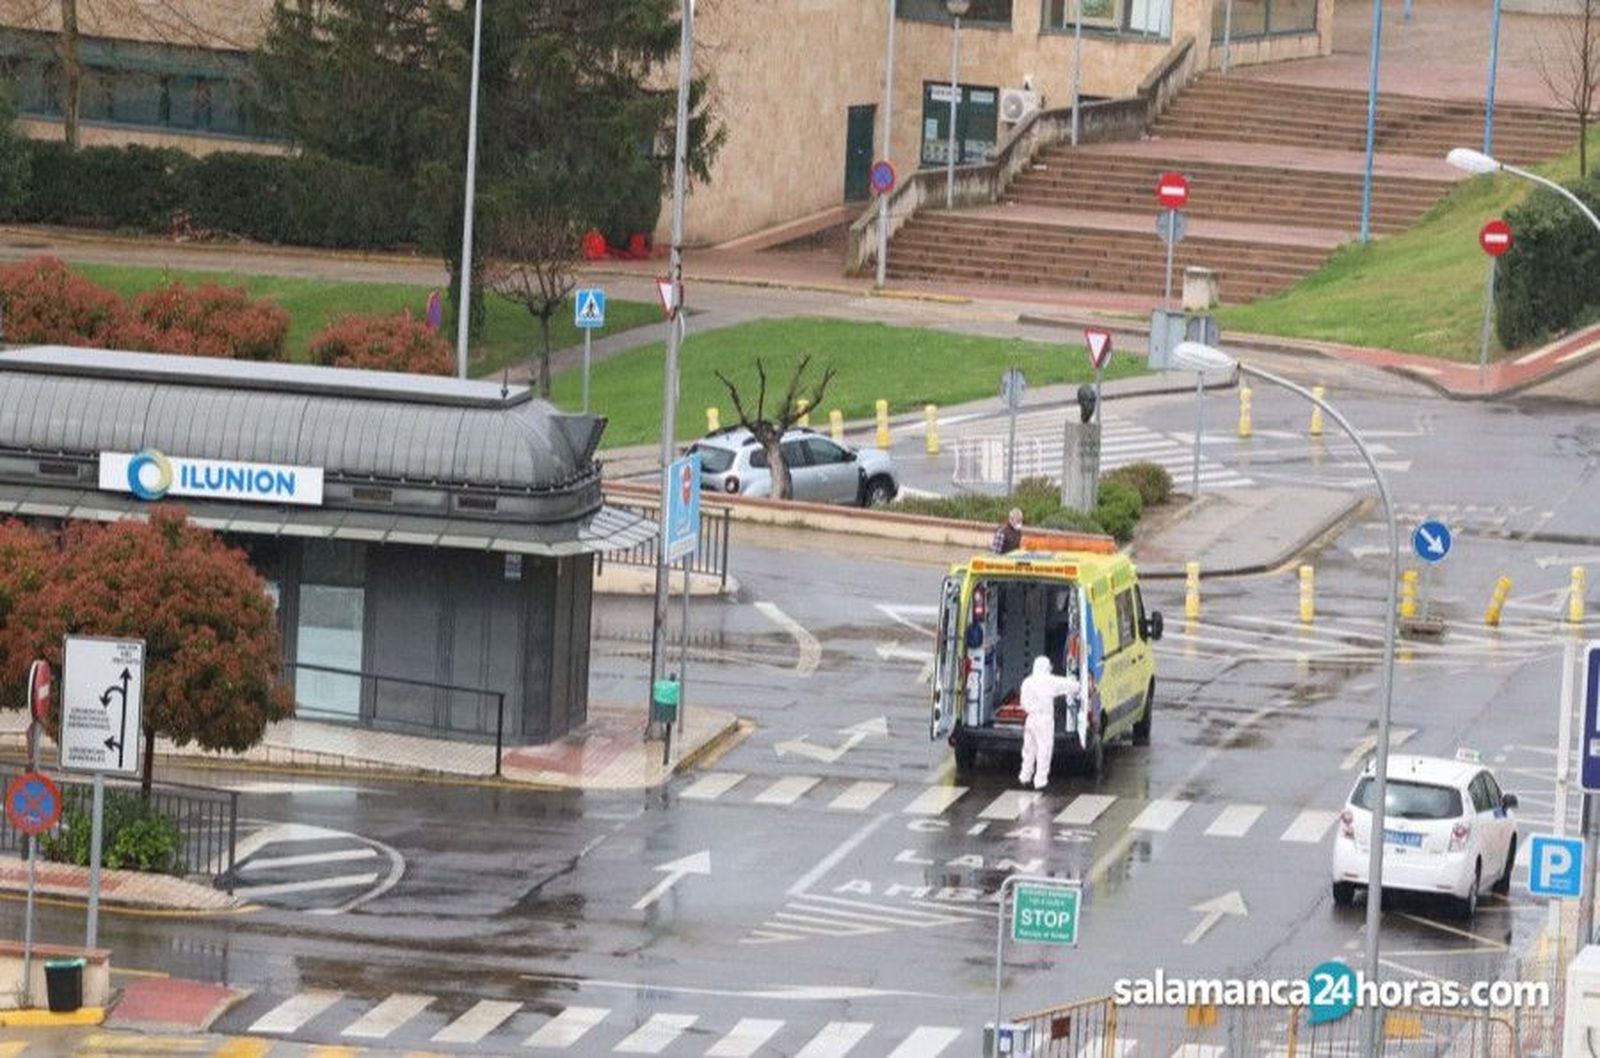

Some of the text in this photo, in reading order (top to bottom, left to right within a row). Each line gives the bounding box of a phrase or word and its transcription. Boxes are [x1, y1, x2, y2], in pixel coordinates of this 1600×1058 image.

[181, 464, 296, 496] ILUNION
[1540, 845, 1572, 887] P
[1021, 908, 1070, 928] STOP
